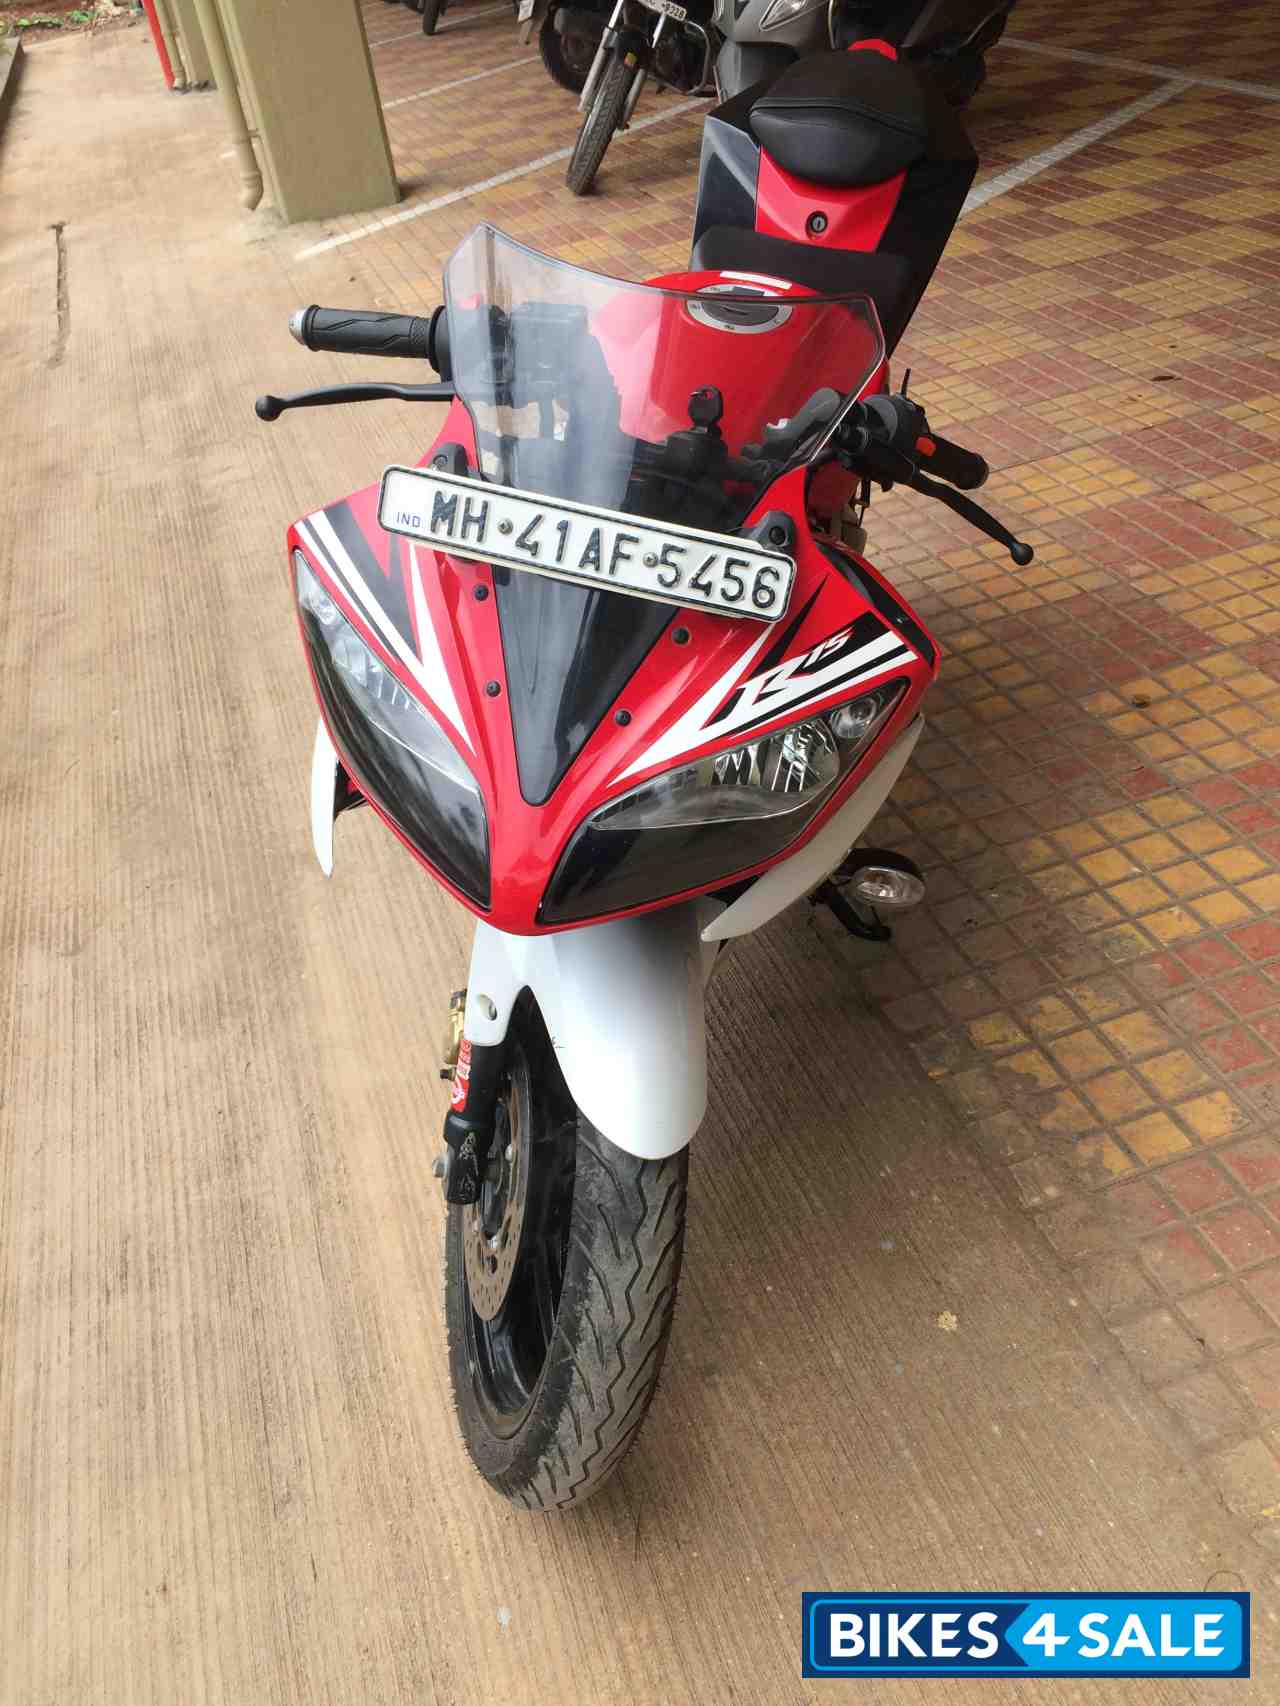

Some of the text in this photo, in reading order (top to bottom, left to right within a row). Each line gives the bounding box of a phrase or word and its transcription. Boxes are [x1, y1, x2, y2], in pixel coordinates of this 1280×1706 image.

[395, 511, 421, 529] IND
[429, 490, 490, 543] MH
[655, 543, 782, 610] 5456
